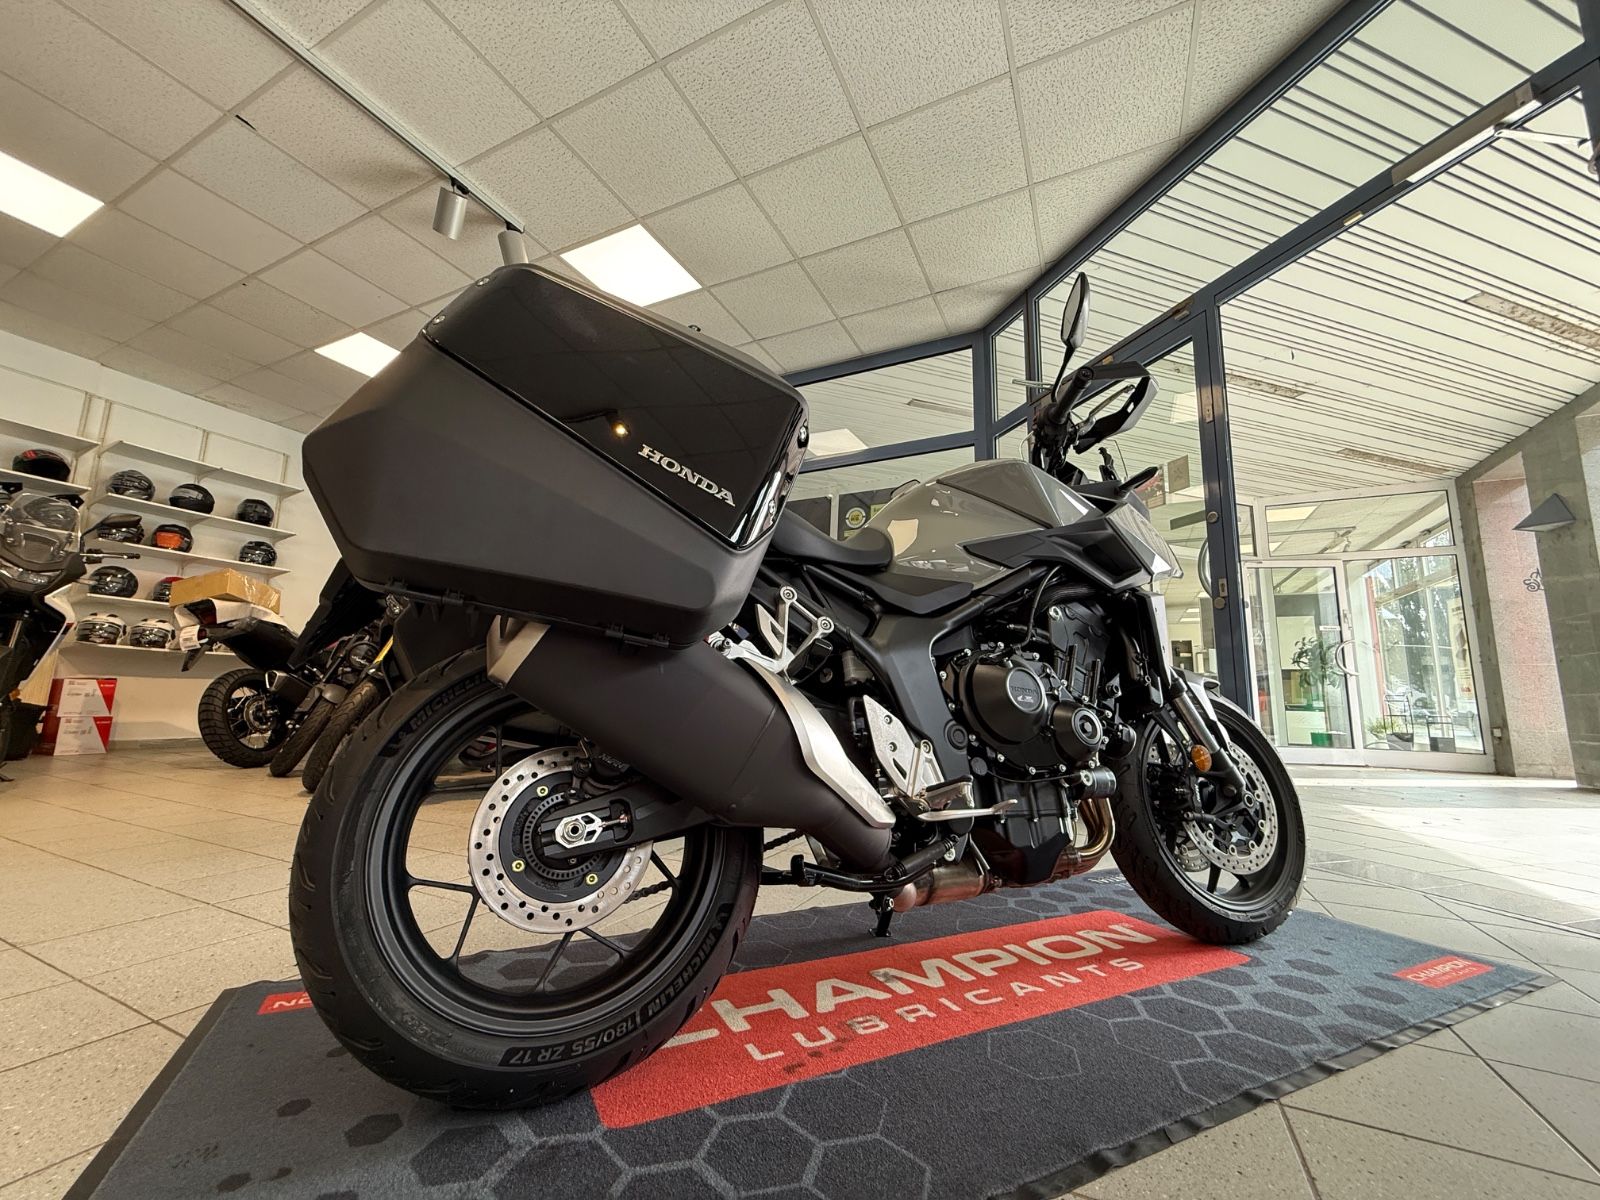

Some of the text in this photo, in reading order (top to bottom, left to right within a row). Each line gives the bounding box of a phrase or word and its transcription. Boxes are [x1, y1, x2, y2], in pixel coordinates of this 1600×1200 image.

[638, 444, 735, 507] HONDA
[510, 934, 717, 1064] MICHELIN 180/55 ZR 17
[744, 957, 1144, 1061] LUBRICANTS
